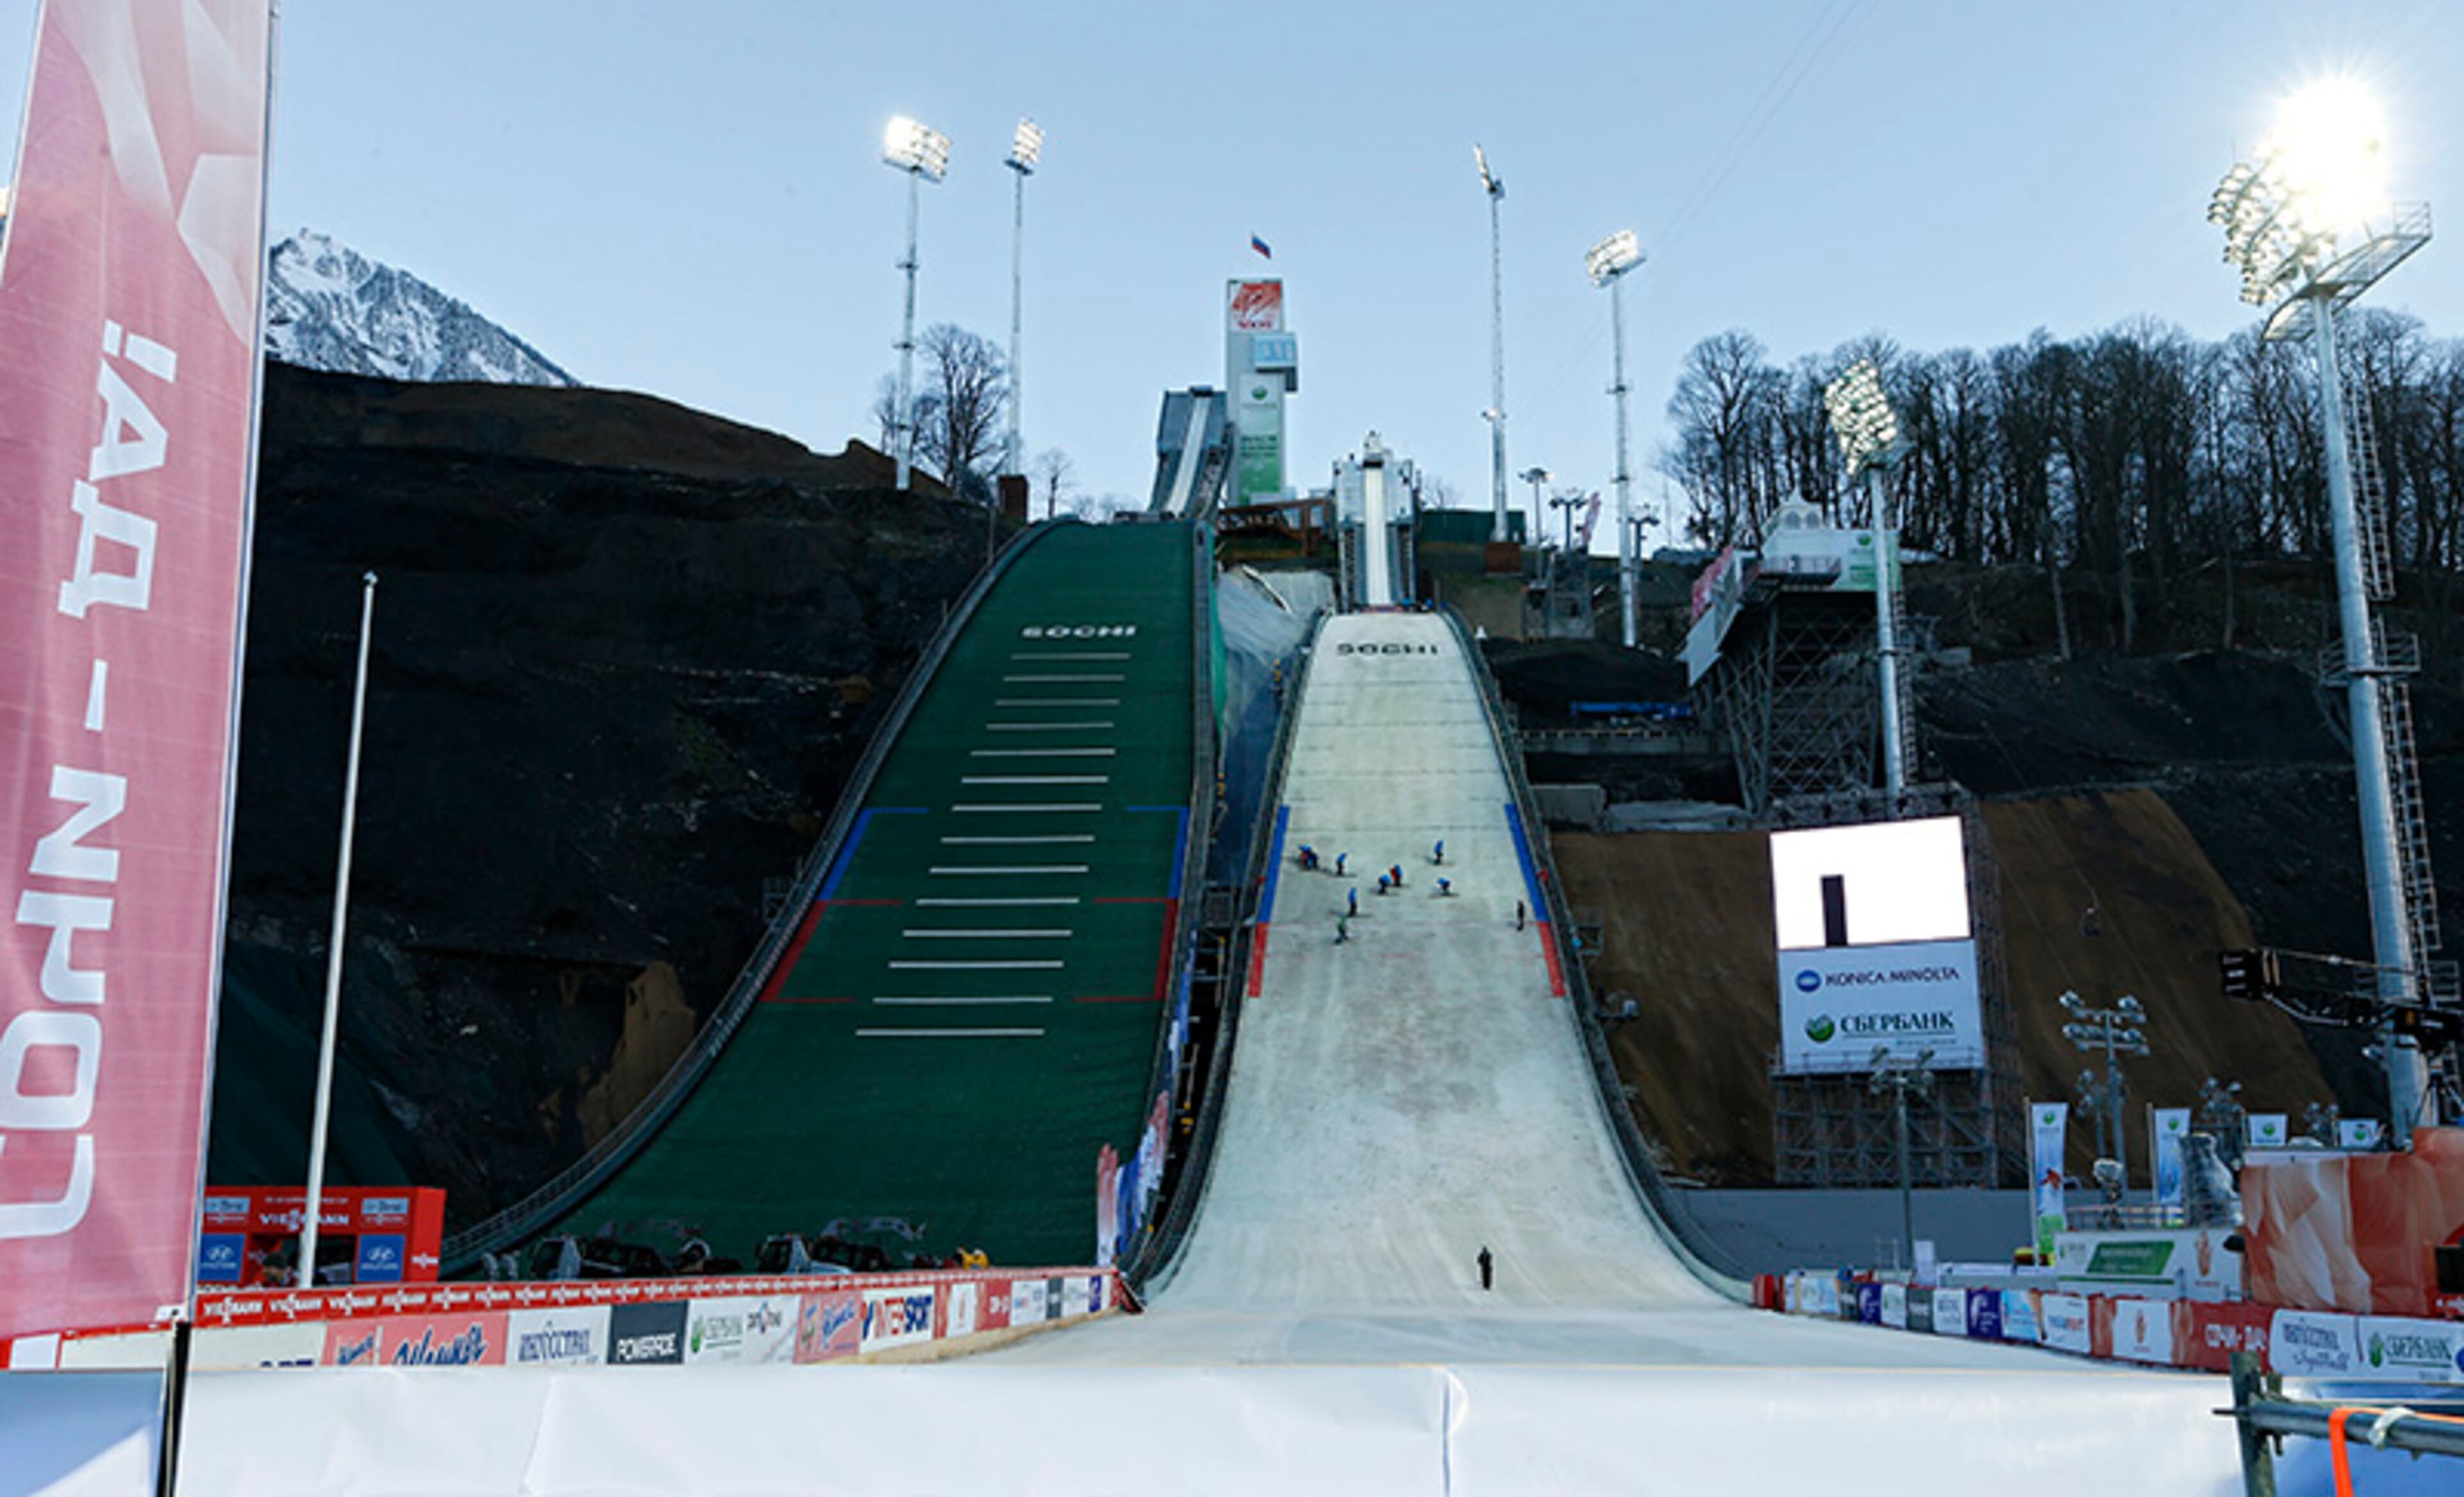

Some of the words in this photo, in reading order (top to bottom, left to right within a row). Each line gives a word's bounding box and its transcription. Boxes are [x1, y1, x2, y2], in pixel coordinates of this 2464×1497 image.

[1023, 626, 1137, 639] SOCHI
[1337, 644, 1439, 656] SOCHI
[1826, 970, 1885, 988] KONICA
[1889, 966, 1959, 984] MINOLTA
[1840, 1010, 1954, 1034] СБЕРБАНК
